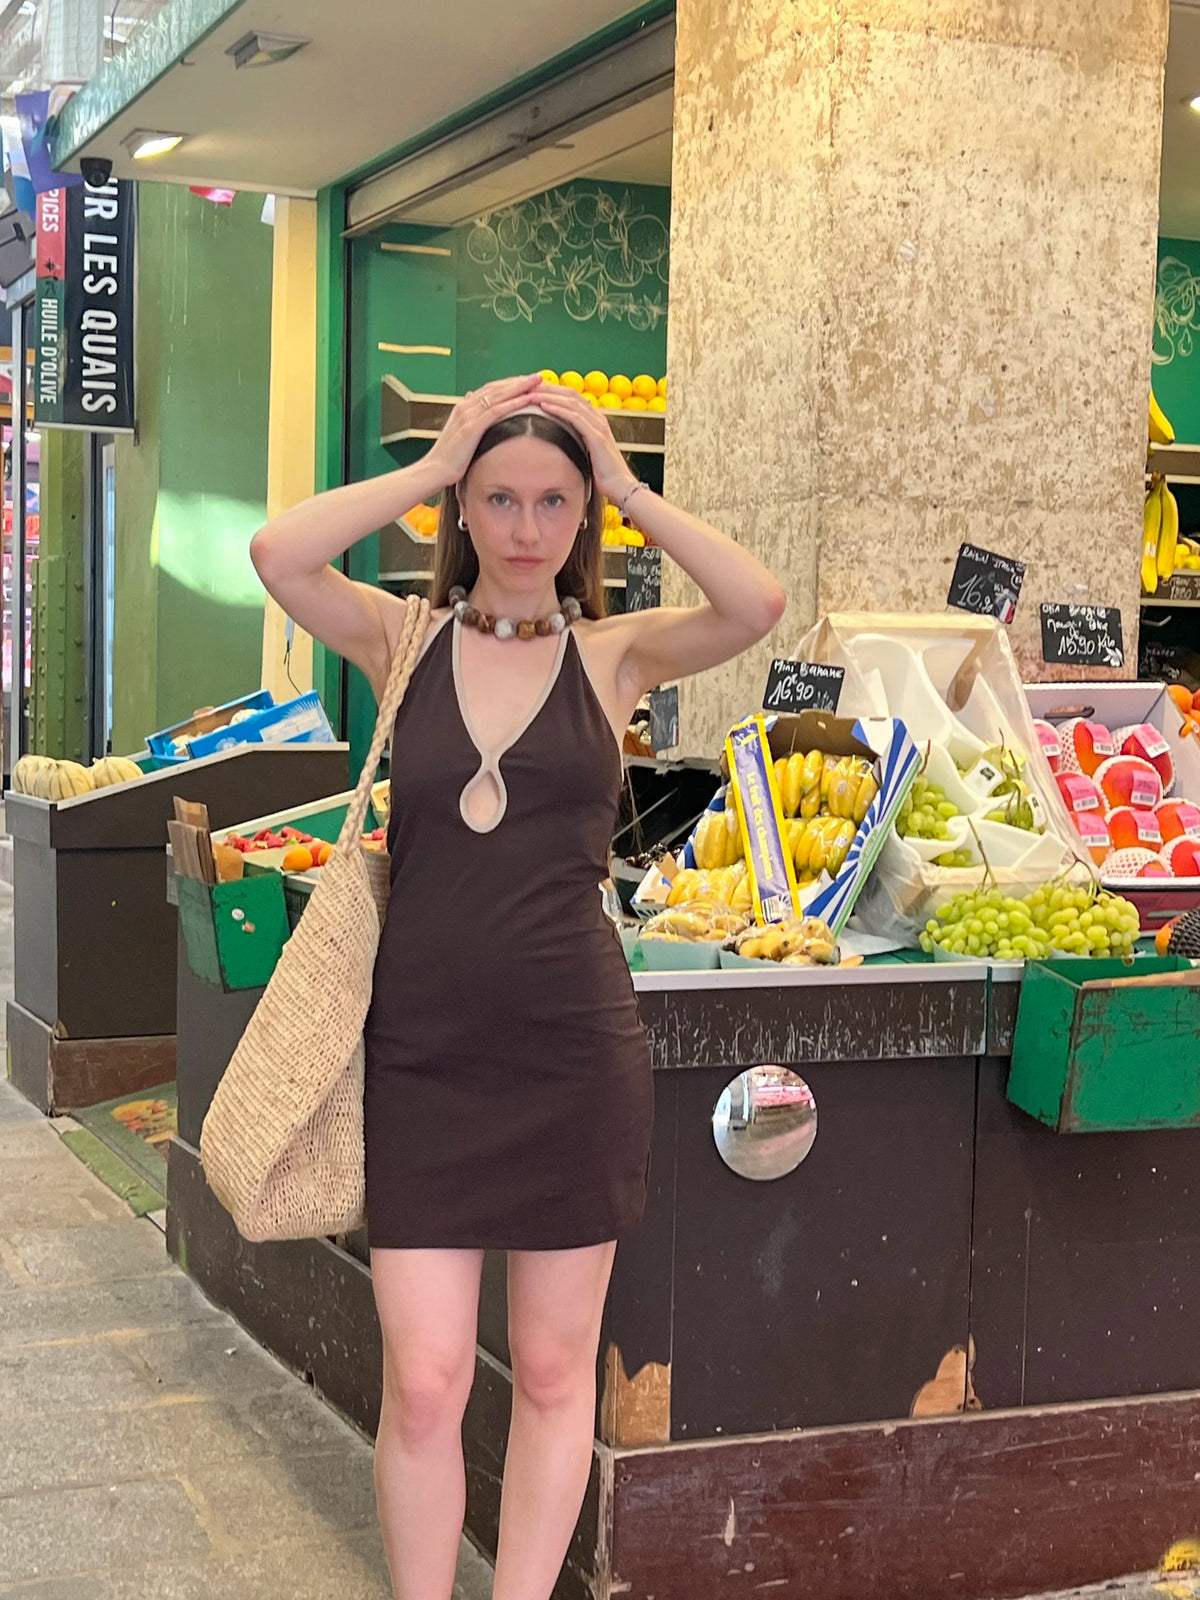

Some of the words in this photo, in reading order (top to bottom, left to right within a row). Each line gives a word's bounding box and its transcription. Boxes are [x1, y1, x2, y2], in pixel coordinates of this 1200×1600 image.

[83, 233, 118, 294] LES
[41, 298, 58, 342] HUILE
[40, 347, 57, 404] D'OLIVE
[81, 309, 117, 413] QUAIS
